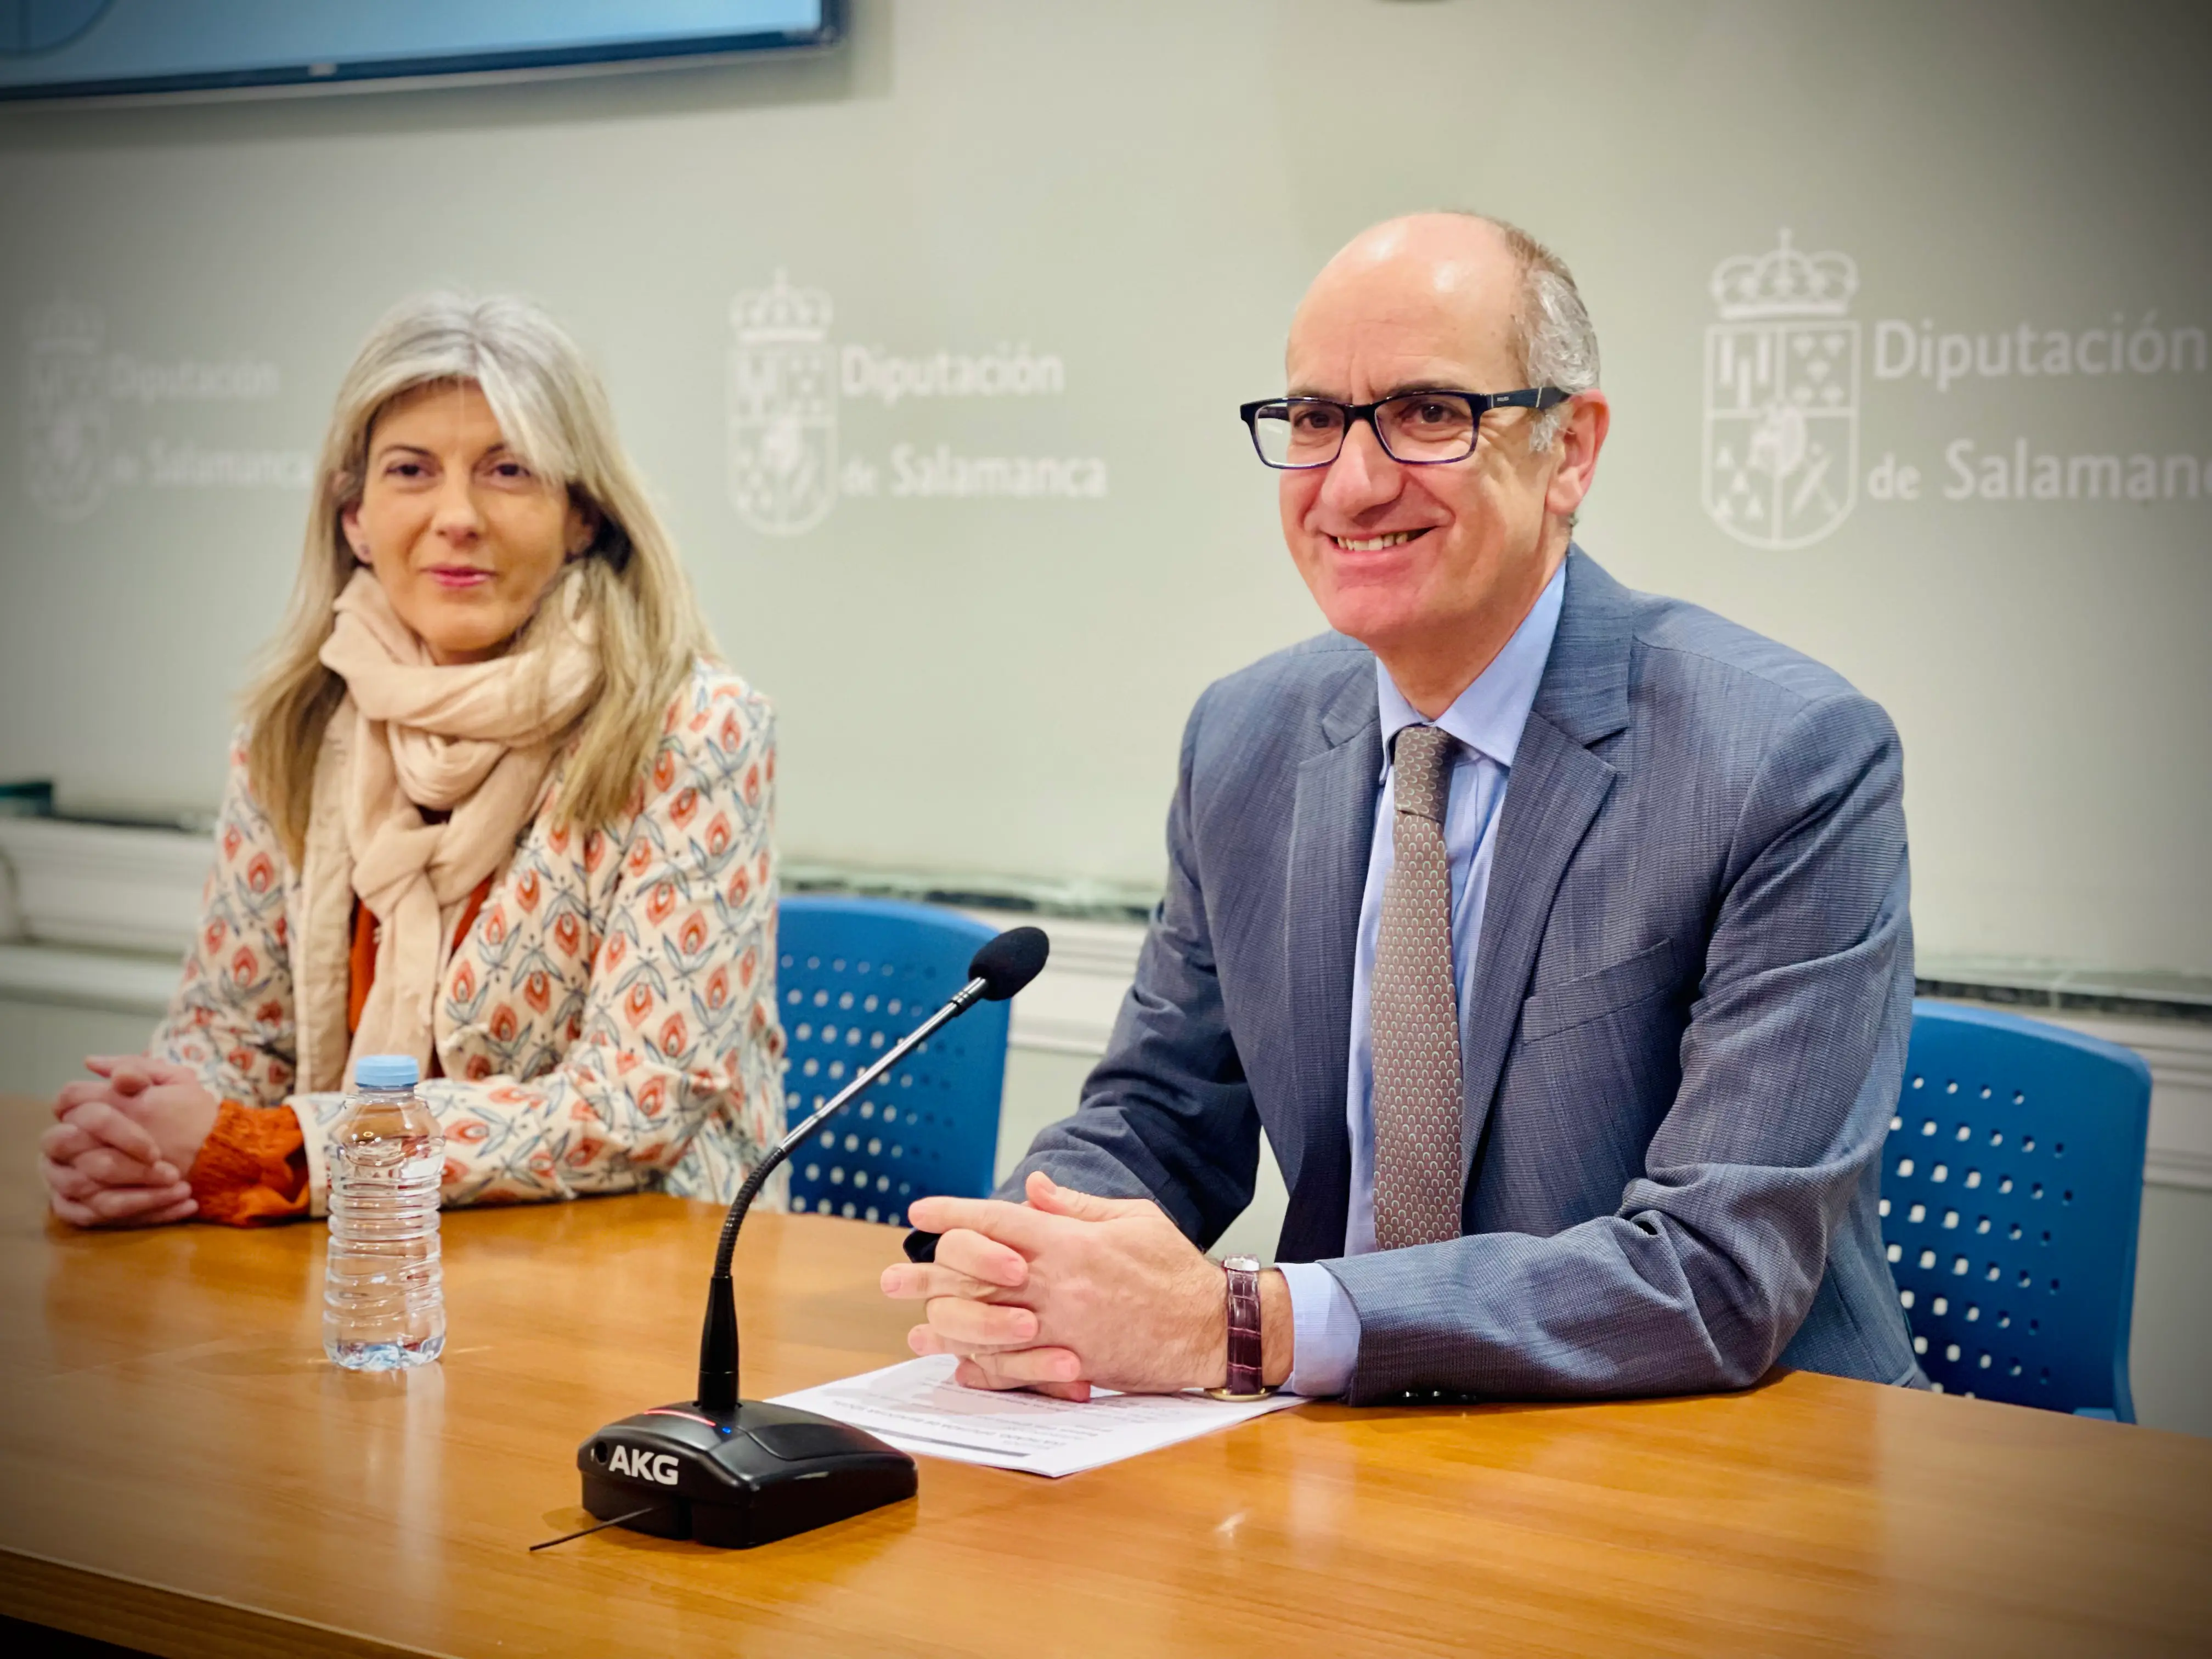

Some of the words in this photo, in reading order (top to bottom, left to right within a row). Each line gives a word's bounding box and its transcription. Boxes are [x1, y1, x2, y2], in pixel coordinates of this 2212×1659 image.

[841, 340, 1064, 407] Diputación
[1874, 308, 2207, 392] Diputación
[890, 442, 1108, 499] Salamanca
[1867, 451, 1921, 500] de
[608, 1445, 679, 1485] AKG
